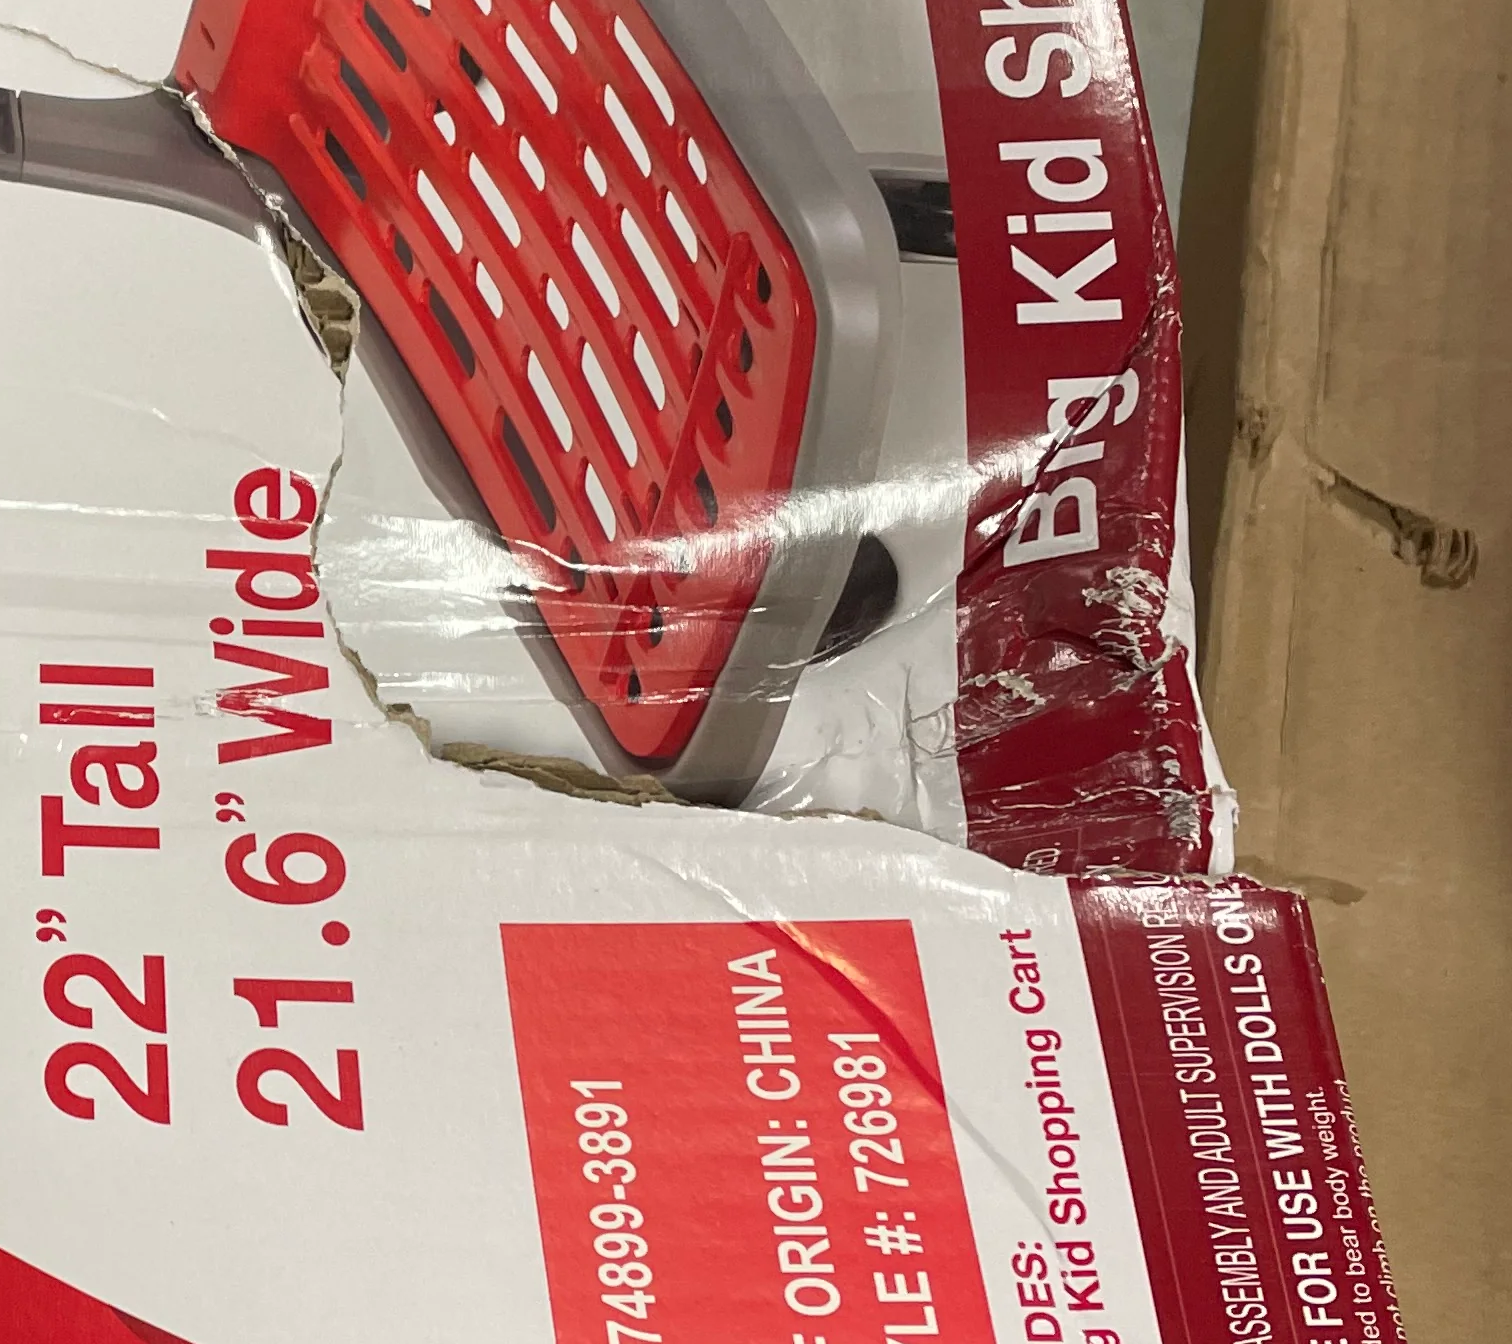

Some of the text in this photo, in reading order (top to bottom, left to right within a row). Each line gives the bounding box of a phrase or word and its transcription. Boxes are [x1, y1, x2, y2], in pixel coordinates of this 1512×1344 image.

[998, 136, 1123, 326] Kid
[1003, 369, 1138, 568] Big
[206, 466, 364, 1131] 21.6” Wide
[36, 663, 170, 1125] 22” Tall
[1000, 929, 1046, 1015] Cart
[1147, 935, 1216, 1084] SUPERVISION
[1225, 954, 1283, 1062] DOLLS
[729, 948, 801, 1101] CHINA
[829, 1032, 910, 1192] 726981
[1026, 1029, 1088, 1225] Shopping
[1180, 1089, 1235, 1165] ADULT
[1252, 1074, 1305, 1160] WITH
[1306, 1086, 1338, 1163] weight.
[761, 1118, 842, 1317] ORIGIN:
[865, 1210, 925, 1256] #:
[1196, 1168, 1246, 1228] AND
[1273, 1170, 1323, 1241] USE
[1325, 1168, 1353, 1222] body
[1056, 1242, 1105, 1311] Kid
[1292, 1251, 1343, 1327] FOR
[1340, 1226, 1365, 1278] bear
[1354, 1281, 1371, 1306] to
